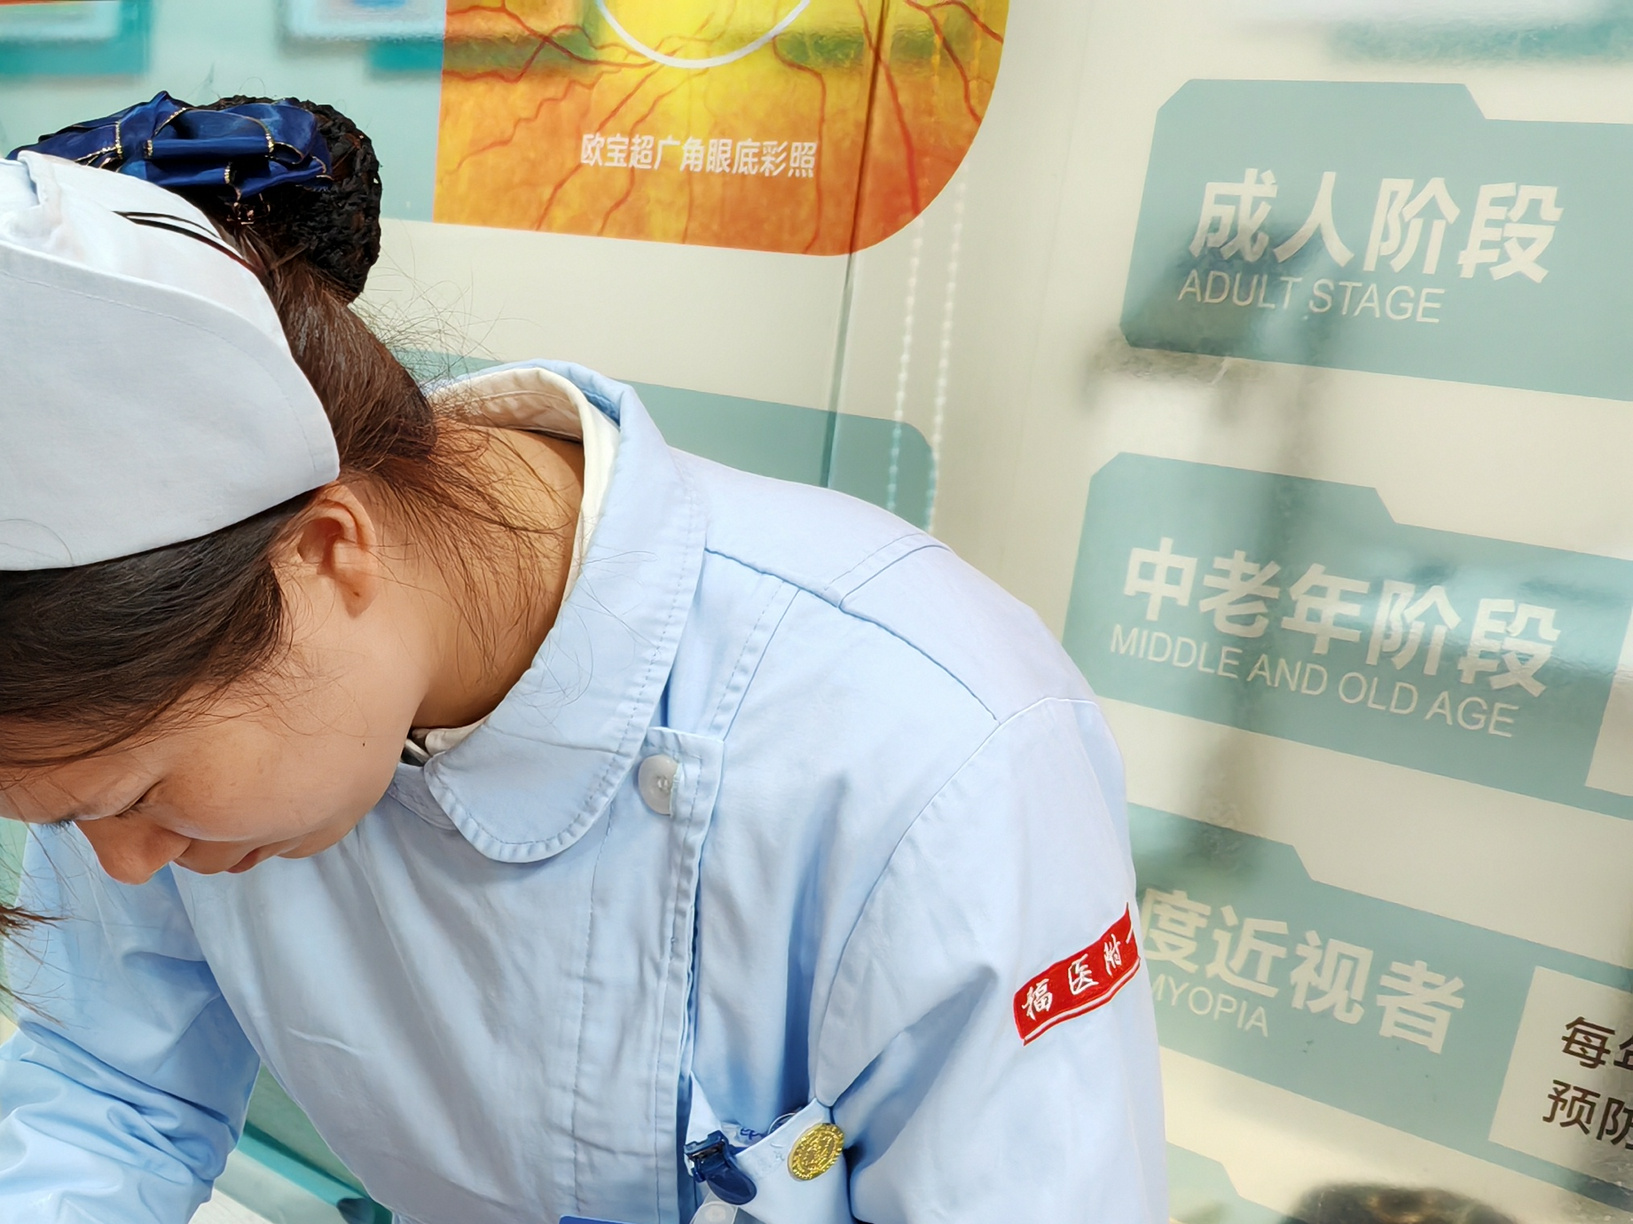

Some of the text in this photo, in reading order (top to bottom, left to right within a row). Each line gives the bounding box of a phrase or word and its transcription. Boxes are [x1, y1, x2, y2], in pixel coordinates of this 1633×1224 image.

[580, 132, 818, 180] 欧宝超广角眼底彩照
[1189, 167, 1564, 283] 成人阶段
[1177, 269, 1445, 324] ADULT STAGE
[1122, 537, 1562, 698] 中老年阶段
[1110, 624, 1520, 738] MIDDLE AND OLD AGE
[1143, 887, 1465, 1055] 度近视者
